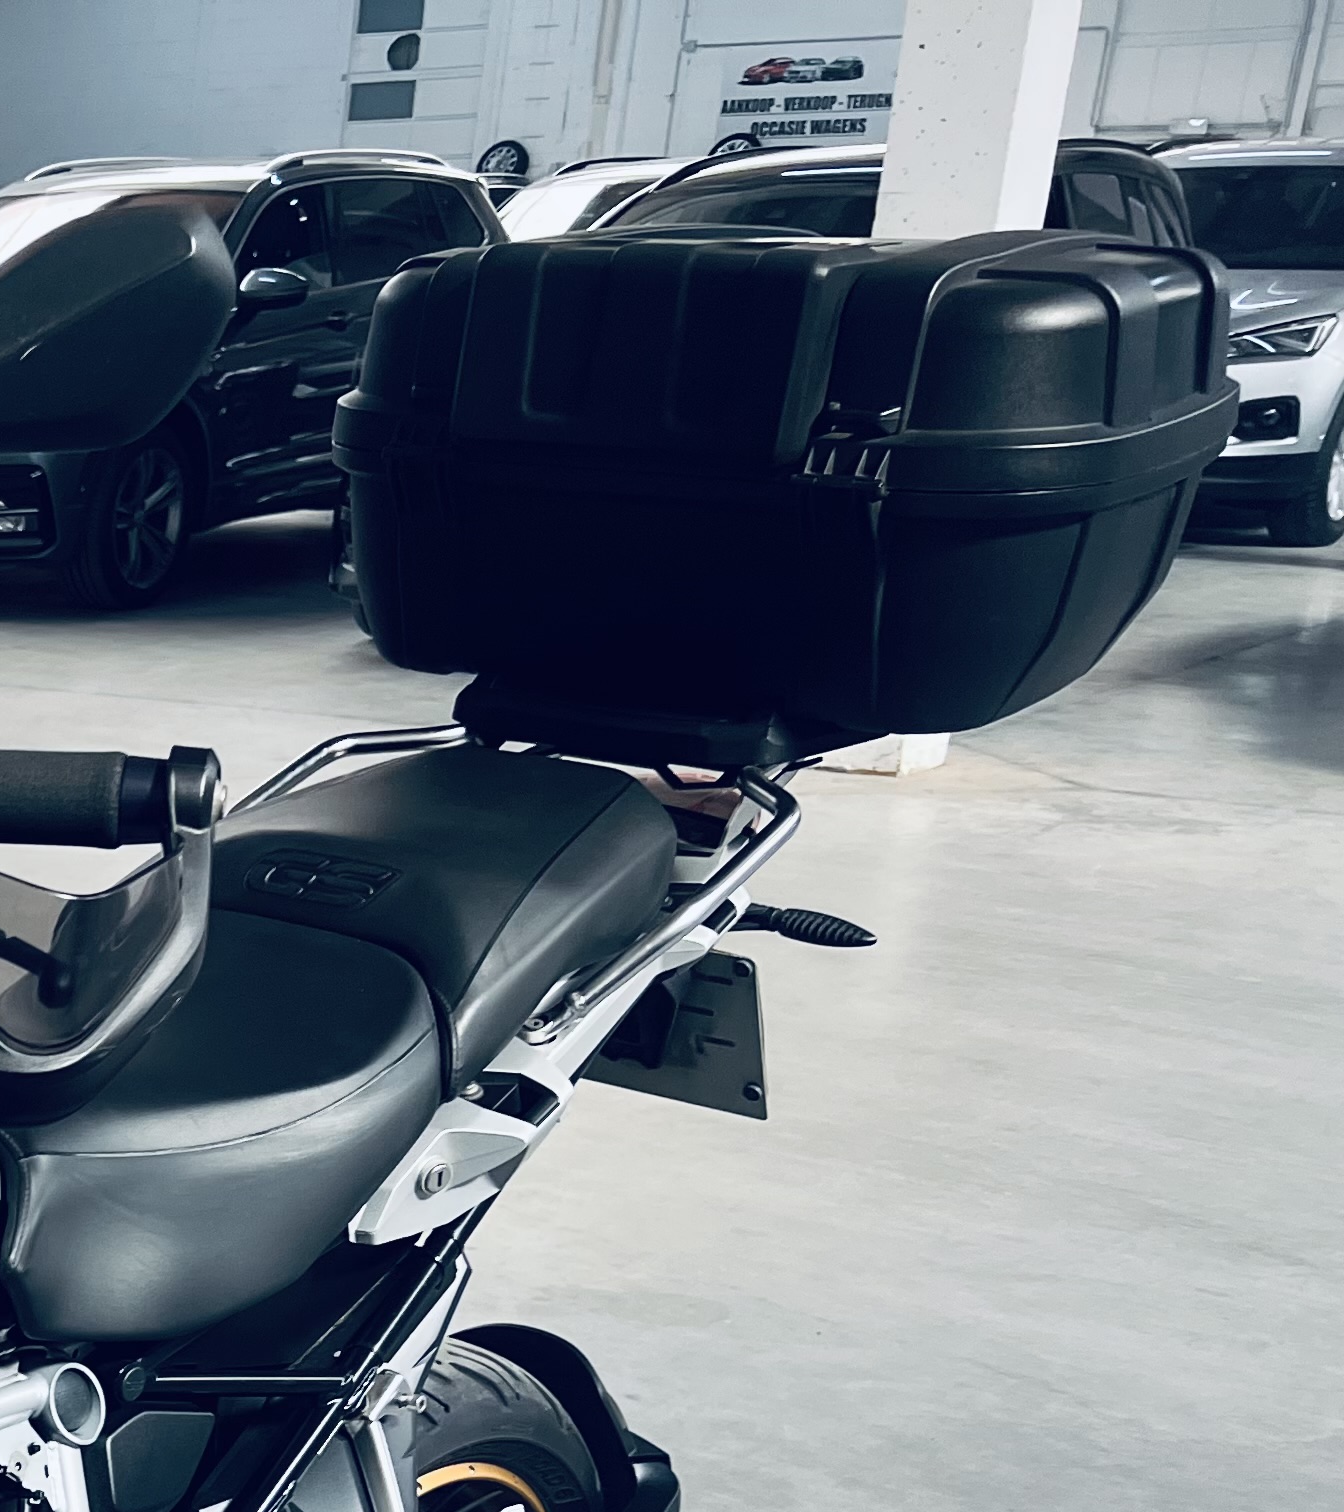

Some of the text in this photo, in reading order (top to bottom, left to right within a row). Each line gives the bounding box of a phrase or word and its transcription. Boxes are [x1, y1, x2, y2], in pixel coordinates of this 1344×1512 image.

[721, 98, 775, 114] AANKOOP
[784, 95, 837, 111] VERKOOP
[750, 118, 867, 136] OCCASIE WAGENS
